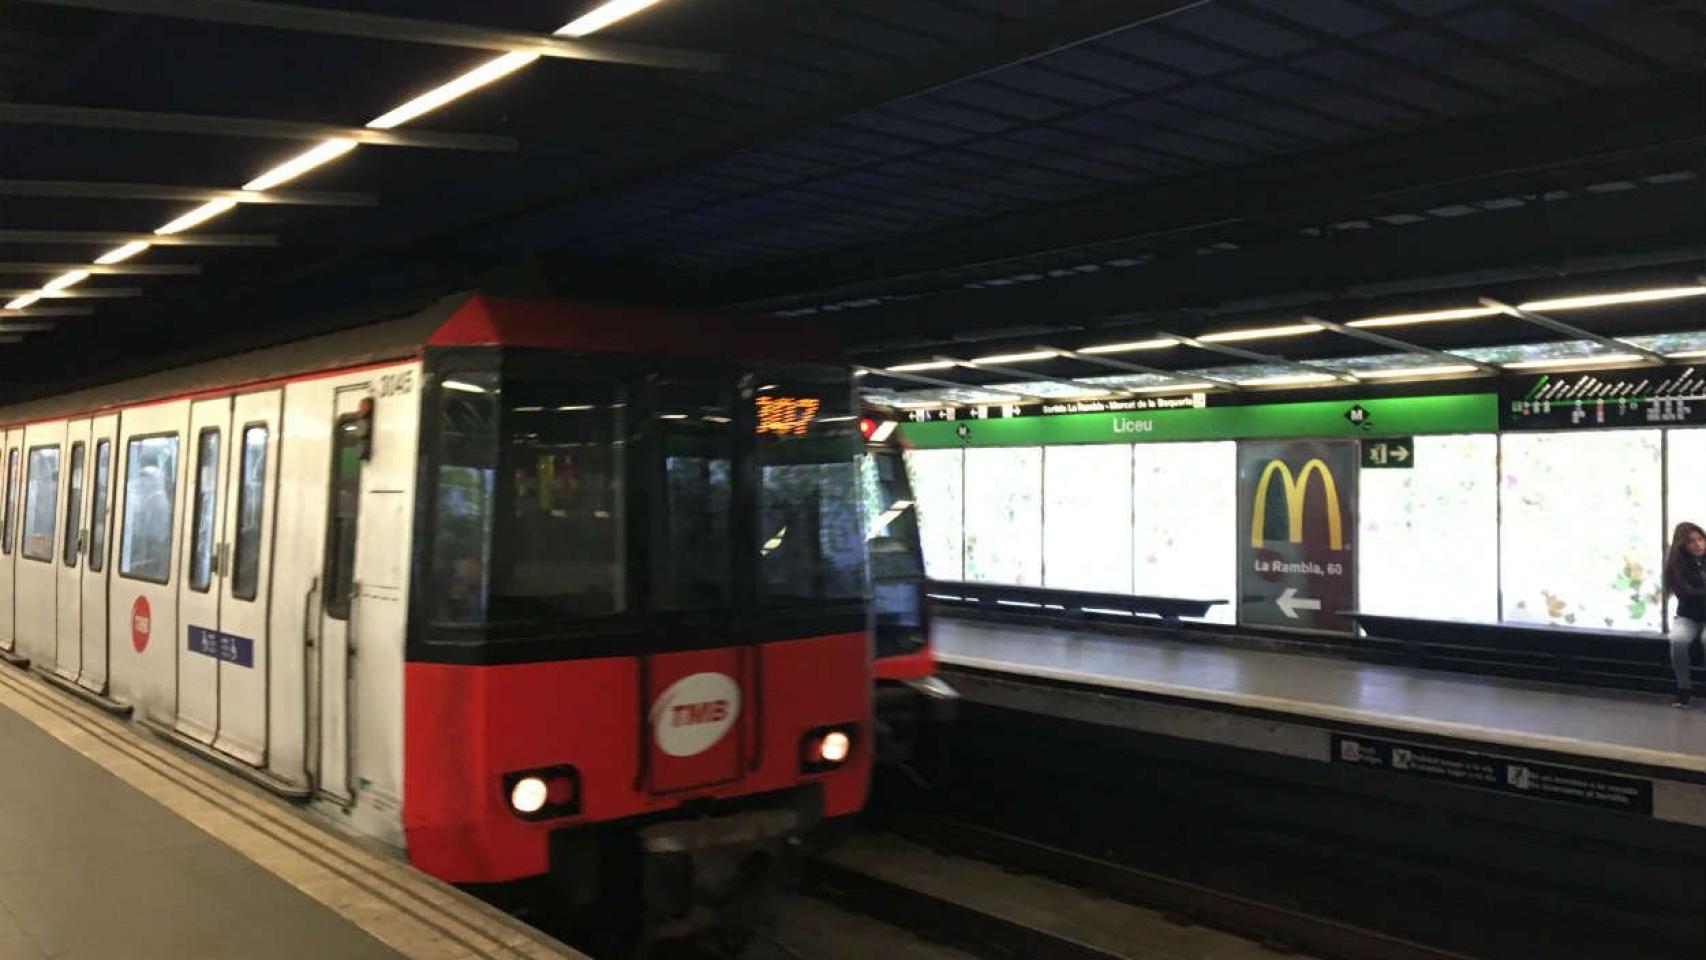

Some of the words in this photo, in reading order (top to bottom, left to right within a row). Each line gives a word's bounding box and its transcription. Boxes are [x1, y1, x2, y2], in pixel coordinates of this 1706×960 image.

[1113, 417, 1152, 433] Liceu
[1255, 560, 1269, 572] La
[1272, 560, 1325, 576] Rambla,
[1327, 563, 1342, 576] 60
[671, 700, 729, 727] TMB
